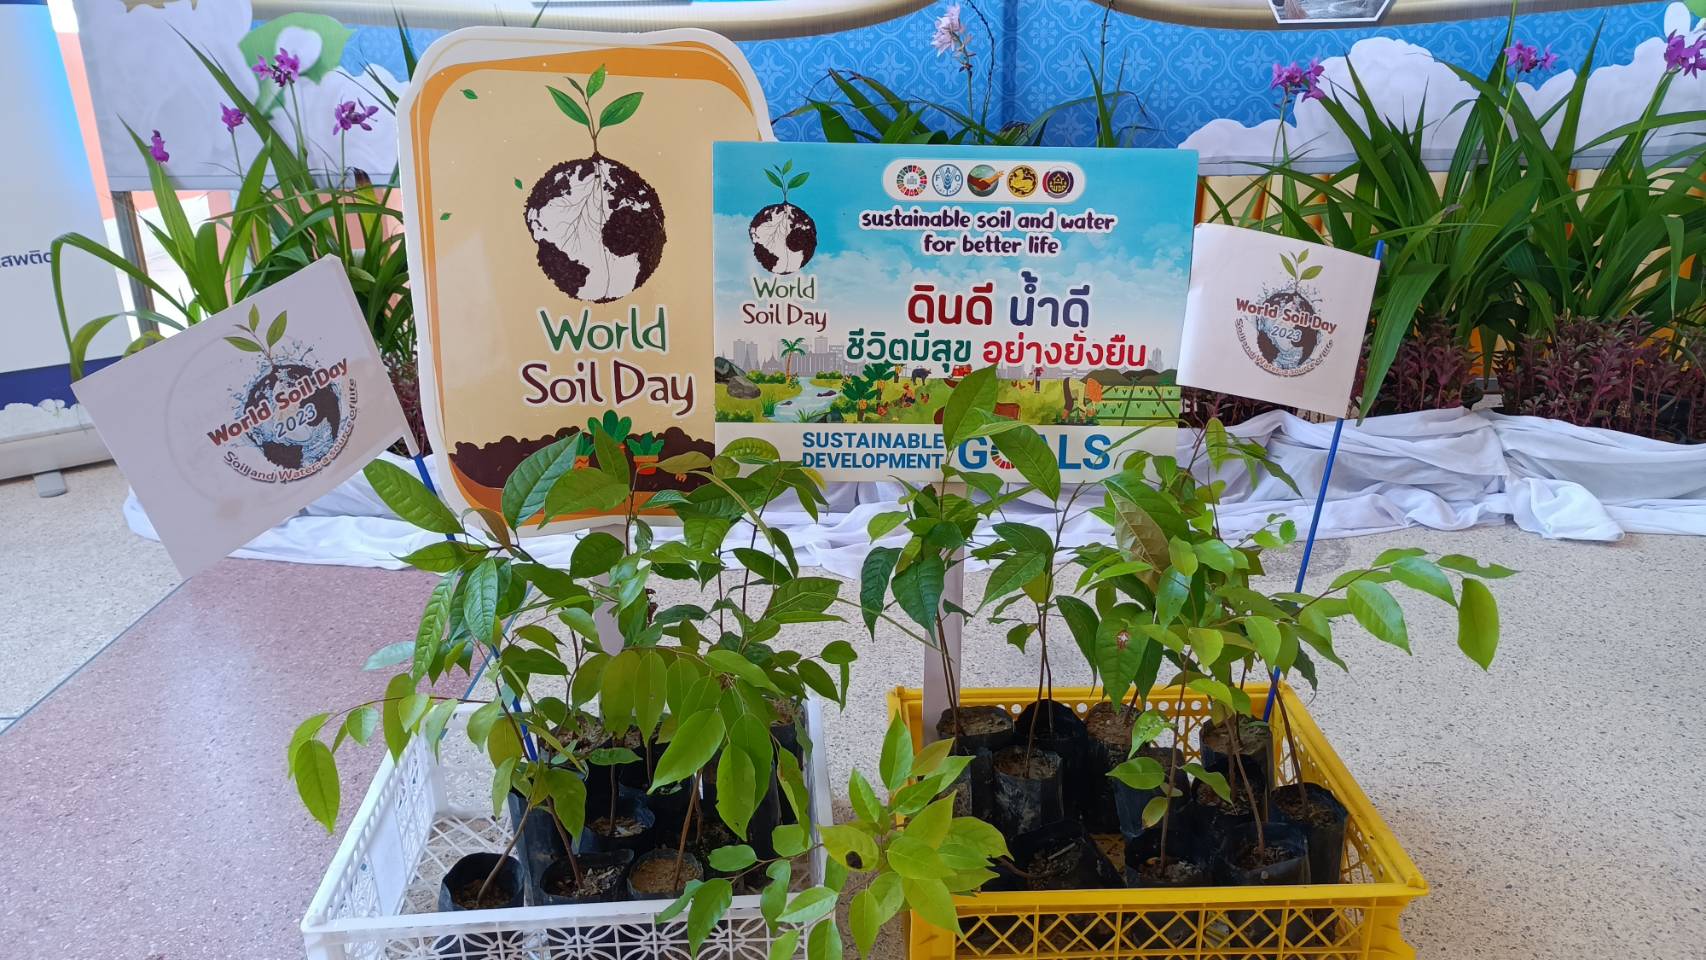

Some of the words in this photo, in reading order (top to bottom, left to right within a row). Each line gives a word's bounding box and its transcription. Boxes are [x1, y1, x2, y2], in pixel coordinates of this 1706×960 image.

[861, 208, 971, 228] sustainable
[977, 210, 1011, 229] soil
[1018, 212, 1054, 229] and
[1061, 211, 1115, 230] water
[924, 234, 956, 253] for
[962, 235, 1022, 254] better
[1029, 236, 1059, 254] life
[753, 277, 815, 300] World
[907, 281, 994, 326] ดินดี
[1009, 270, 1091, 328] น้ำดี
[540, 307, 666, 352] World
[742, 303, 782, 325] Soil
[787, 303, 827, 333] Day
[1236, 297, 1279, 319] World
[1282, 308, 1309, 326] Soil
[1311, 315, 1338, 334] Day
[1271, 325, 1302, 342] 2023
[846, 328, 972, 373] ชีวิตมีสุข
[982, 330, 1147, 367] อย่างยั่งยืน
[206, 401, 272, 446] World
[275, 376, 315, 410] Soil
[313, 357, 348, 387] Day
[522, 361, 604, 404] Soil
[613, 360, 694, 416] Day
[275, 404, 316, 438] 2023
[801, 431, 945, 450] SUSTAINABLE
[252, 468, 275, 481] and
[801, 452, 945, 470] DEVELOPMENT
